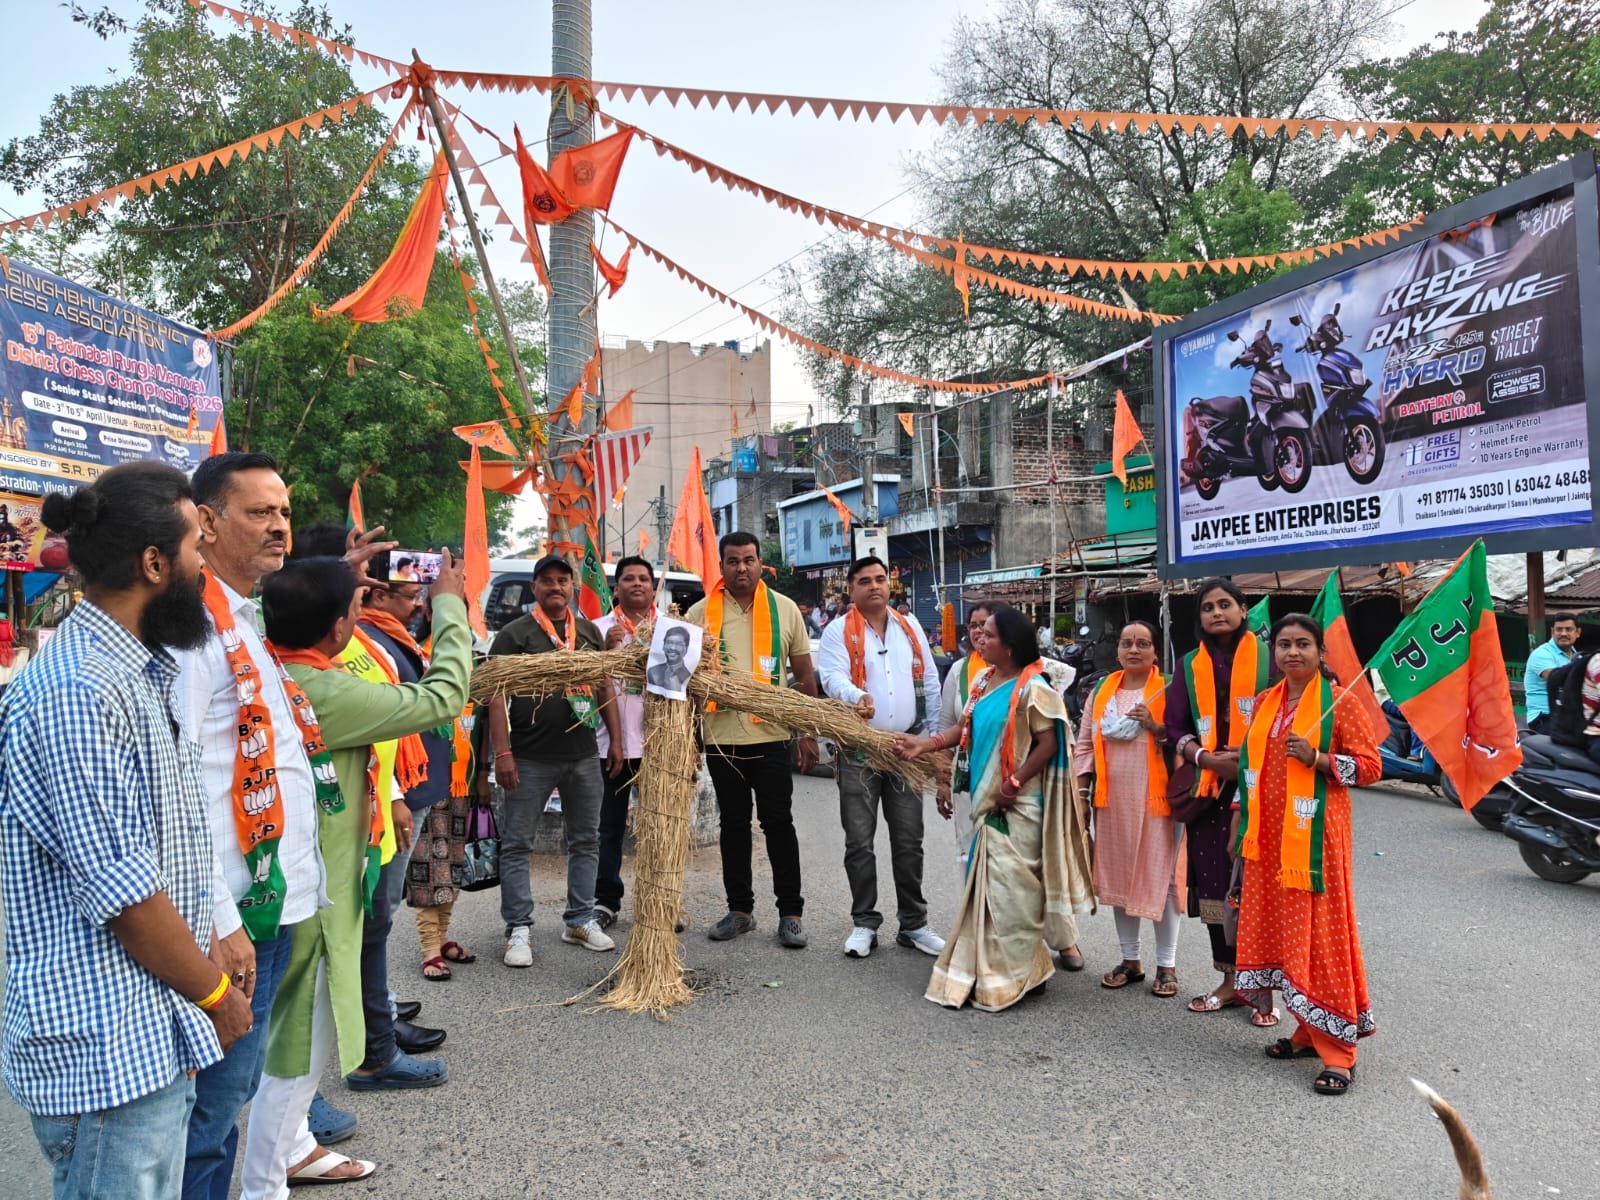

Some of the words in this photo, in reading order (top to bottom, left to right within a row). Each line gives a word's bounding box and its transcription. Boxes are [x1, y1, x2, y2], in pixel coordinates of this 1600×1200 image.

[1532, 200, 1574, 237] BLUE
[8, 266, 119, 320] SINGHBHUM
[1380, 261, 1477, 316] KEEP
[1366, 272, 1543, 352] RAYZING
[54, 302, 165, 352] ASSOCIATION
[123, 309, 189, 346] DISTRICT
[1489, 316, 1544, 346] STREET
[46, 329, 114, 367] Padmabai
[1189, 332, 1215, 351] YAMAHA
[1495, 335, 1540, 362] RALLY
[6, 339, 59, 373] District
[60, 356, 105, 387] Chess
[188, 392, 224, 412] 2026
[1383, 345, 1487, 396] HYBRID
[1493, 372, 1541, 390] POWER
[51, 380, 80, 397] Senior
[82, 388, 106, 402] State
[108, 394, 147, 412] Selection
[1400, 392, 1454, 418] BATTERY
[1491, 384, 1533, 399] ASSIST
[33, 397, 51, 410] Date
[66, 406, 76, 416] To
[86, 411, 102, 422] April
[108, 415, 128, 427] Venue
[1432, 402, 1484, 426] PETROL
[1479, 425, 1495, 436] Full
[1496, 422, 1515, 433] Tank
[1516, 415, 1542, 429] Petrol
[1427, 432, 1457, 448] FREE
[1480, 437, 1510, 450] Helmet
[1511, 432, 1529, 443] Free
[1480, 453, 1489, 463] 10
[1490, 448, 1513, 462] Years
[1514, 445, 1542, 459] Engine
[1544, 437, 1584, 452] Warranty
[40, 461, 52, 469] BY
[1424, 446, 1457, 462] GIFTS
[1417, 493, 1432, 507] +91
[1435, 487, 1467, 504] 87774
[1470, 481, 1504, 499] 35030
[1514, 474, 1551, 493] 63042
[1533, 494, 1566, 507] Manoharpur
[1191, 514, 1250, 542] JAYPEE
[1255, 495, 1381, 534] ENTERPRISES
[243, 767, 276, 791] BJP
[238, 891, 277, 909] BJP
